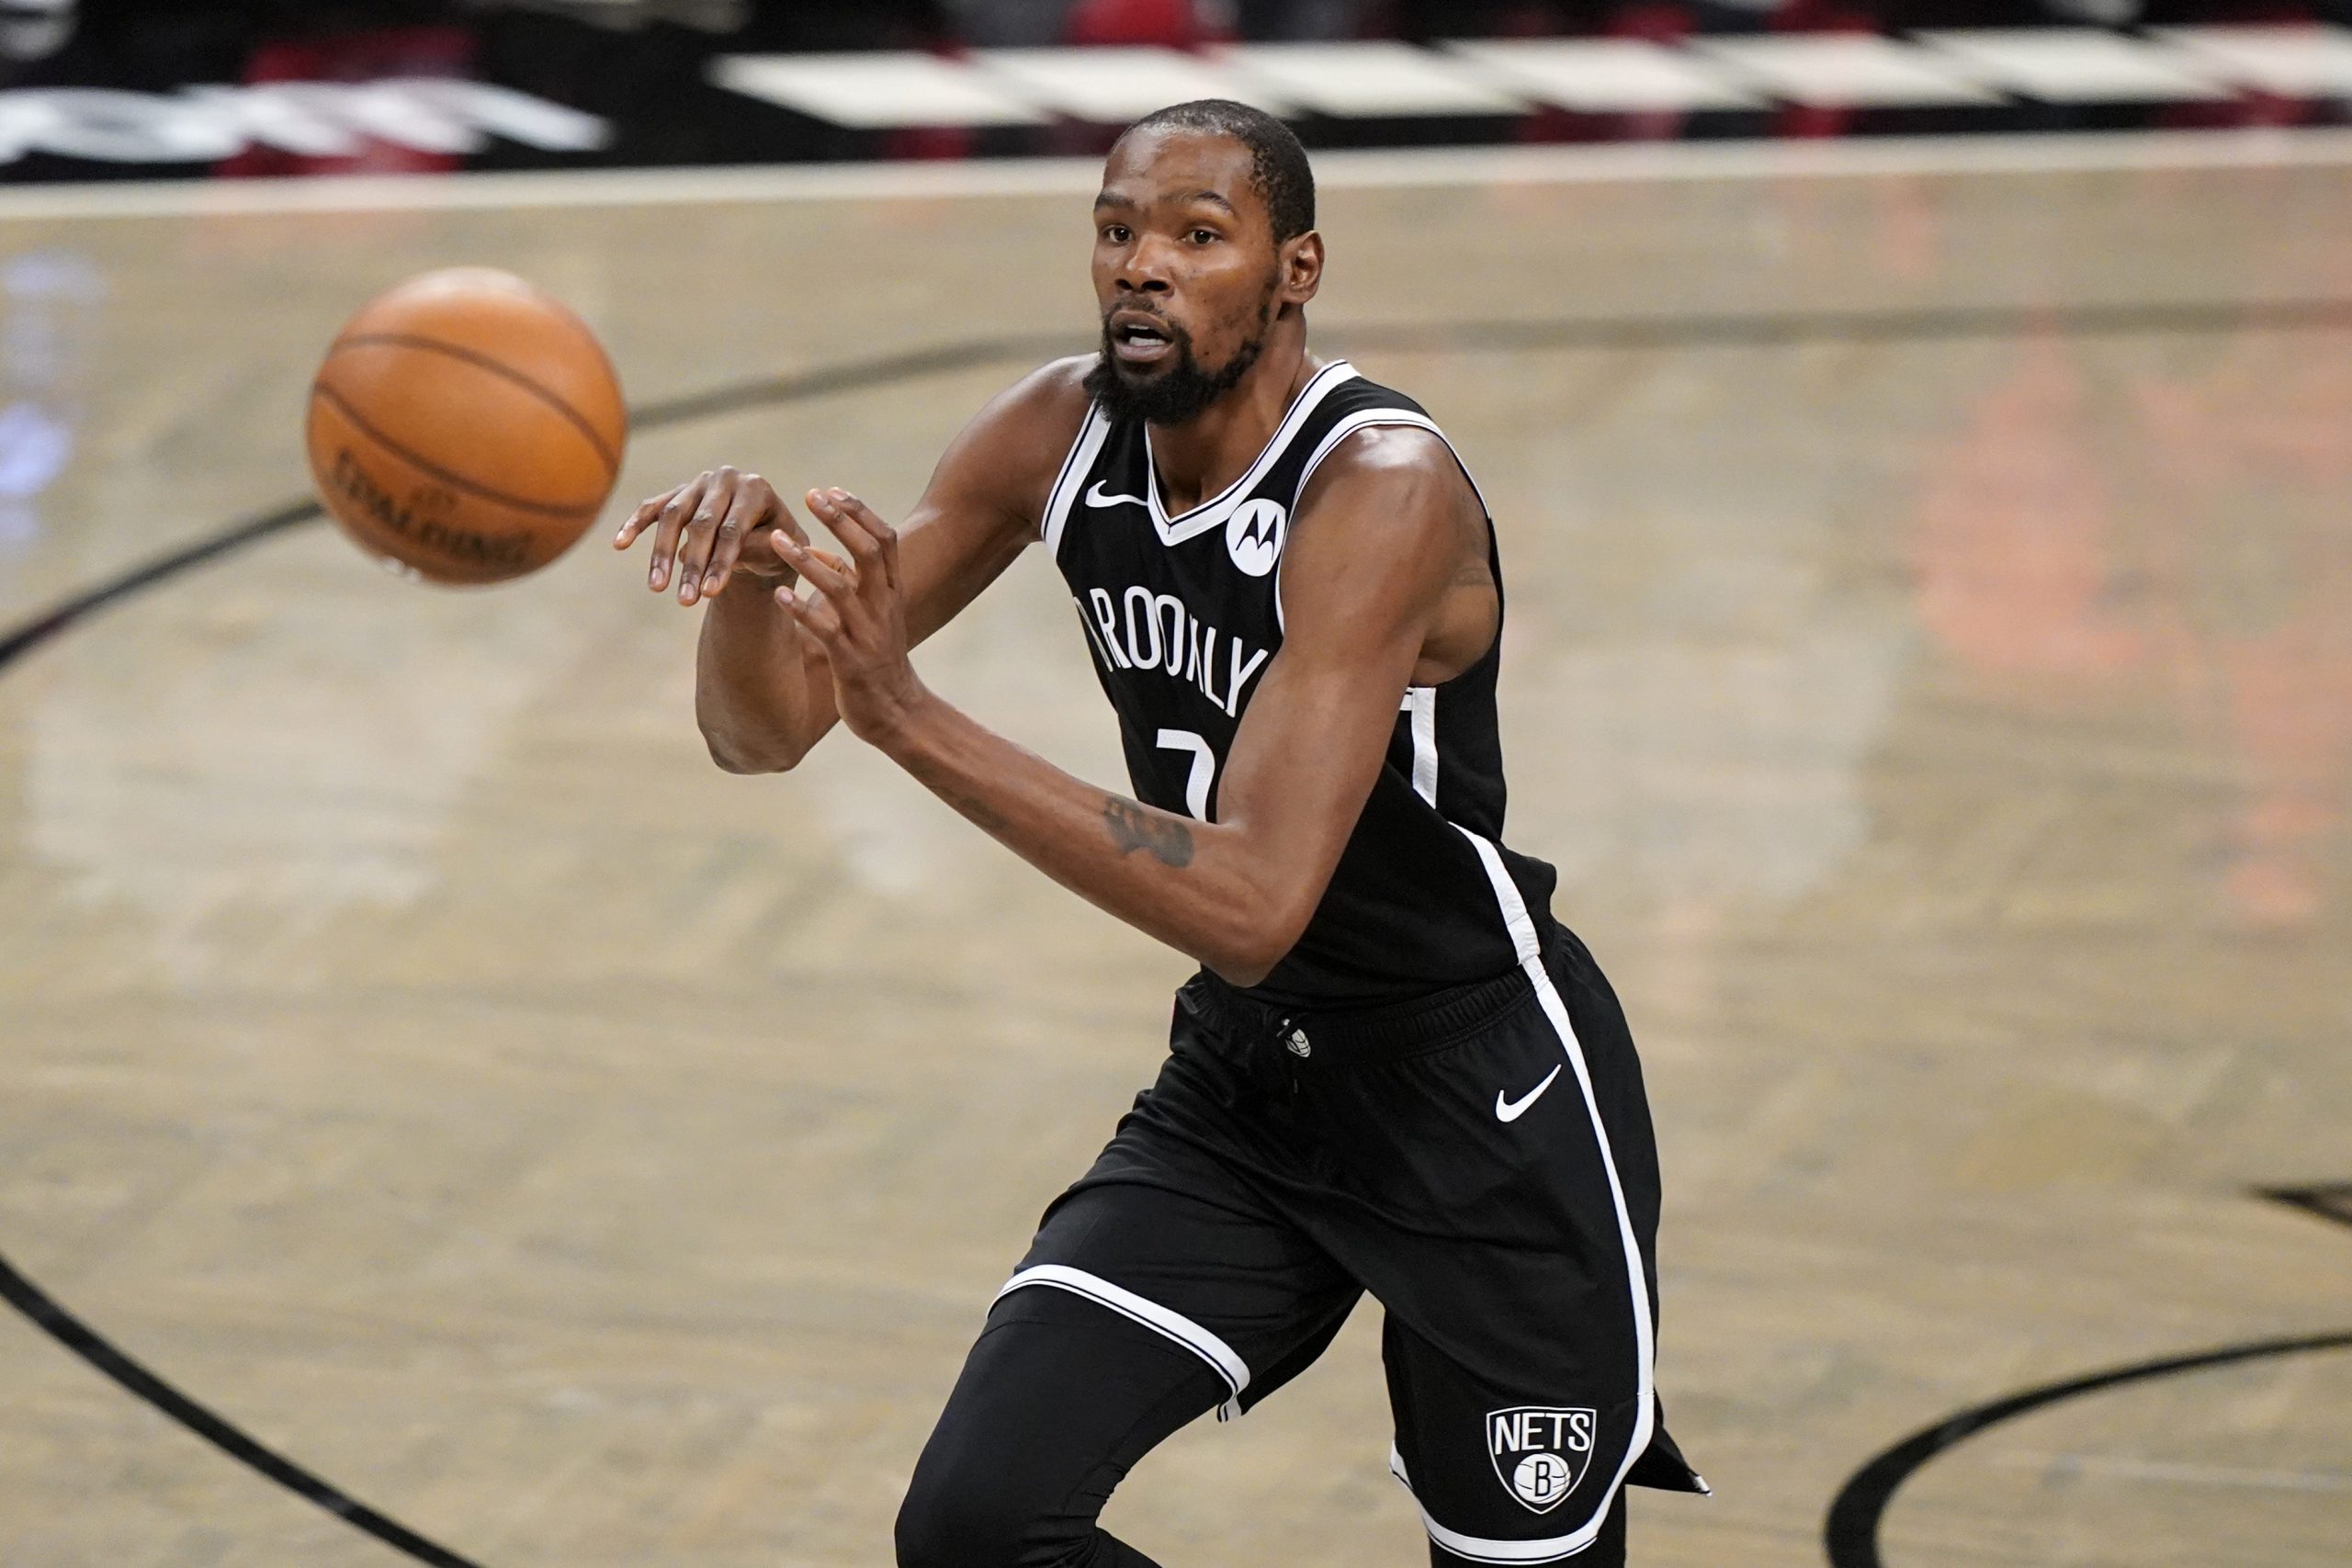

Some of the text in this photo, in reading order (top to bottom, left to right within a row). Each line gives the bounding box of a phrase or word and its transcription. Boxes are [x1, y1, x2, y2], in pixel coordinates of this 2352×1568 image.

[1156, 728, 1216, 823] 7
[1494, 1413, 1591, 1456] NETS
[1534, 1461, 1552, 1497] B
